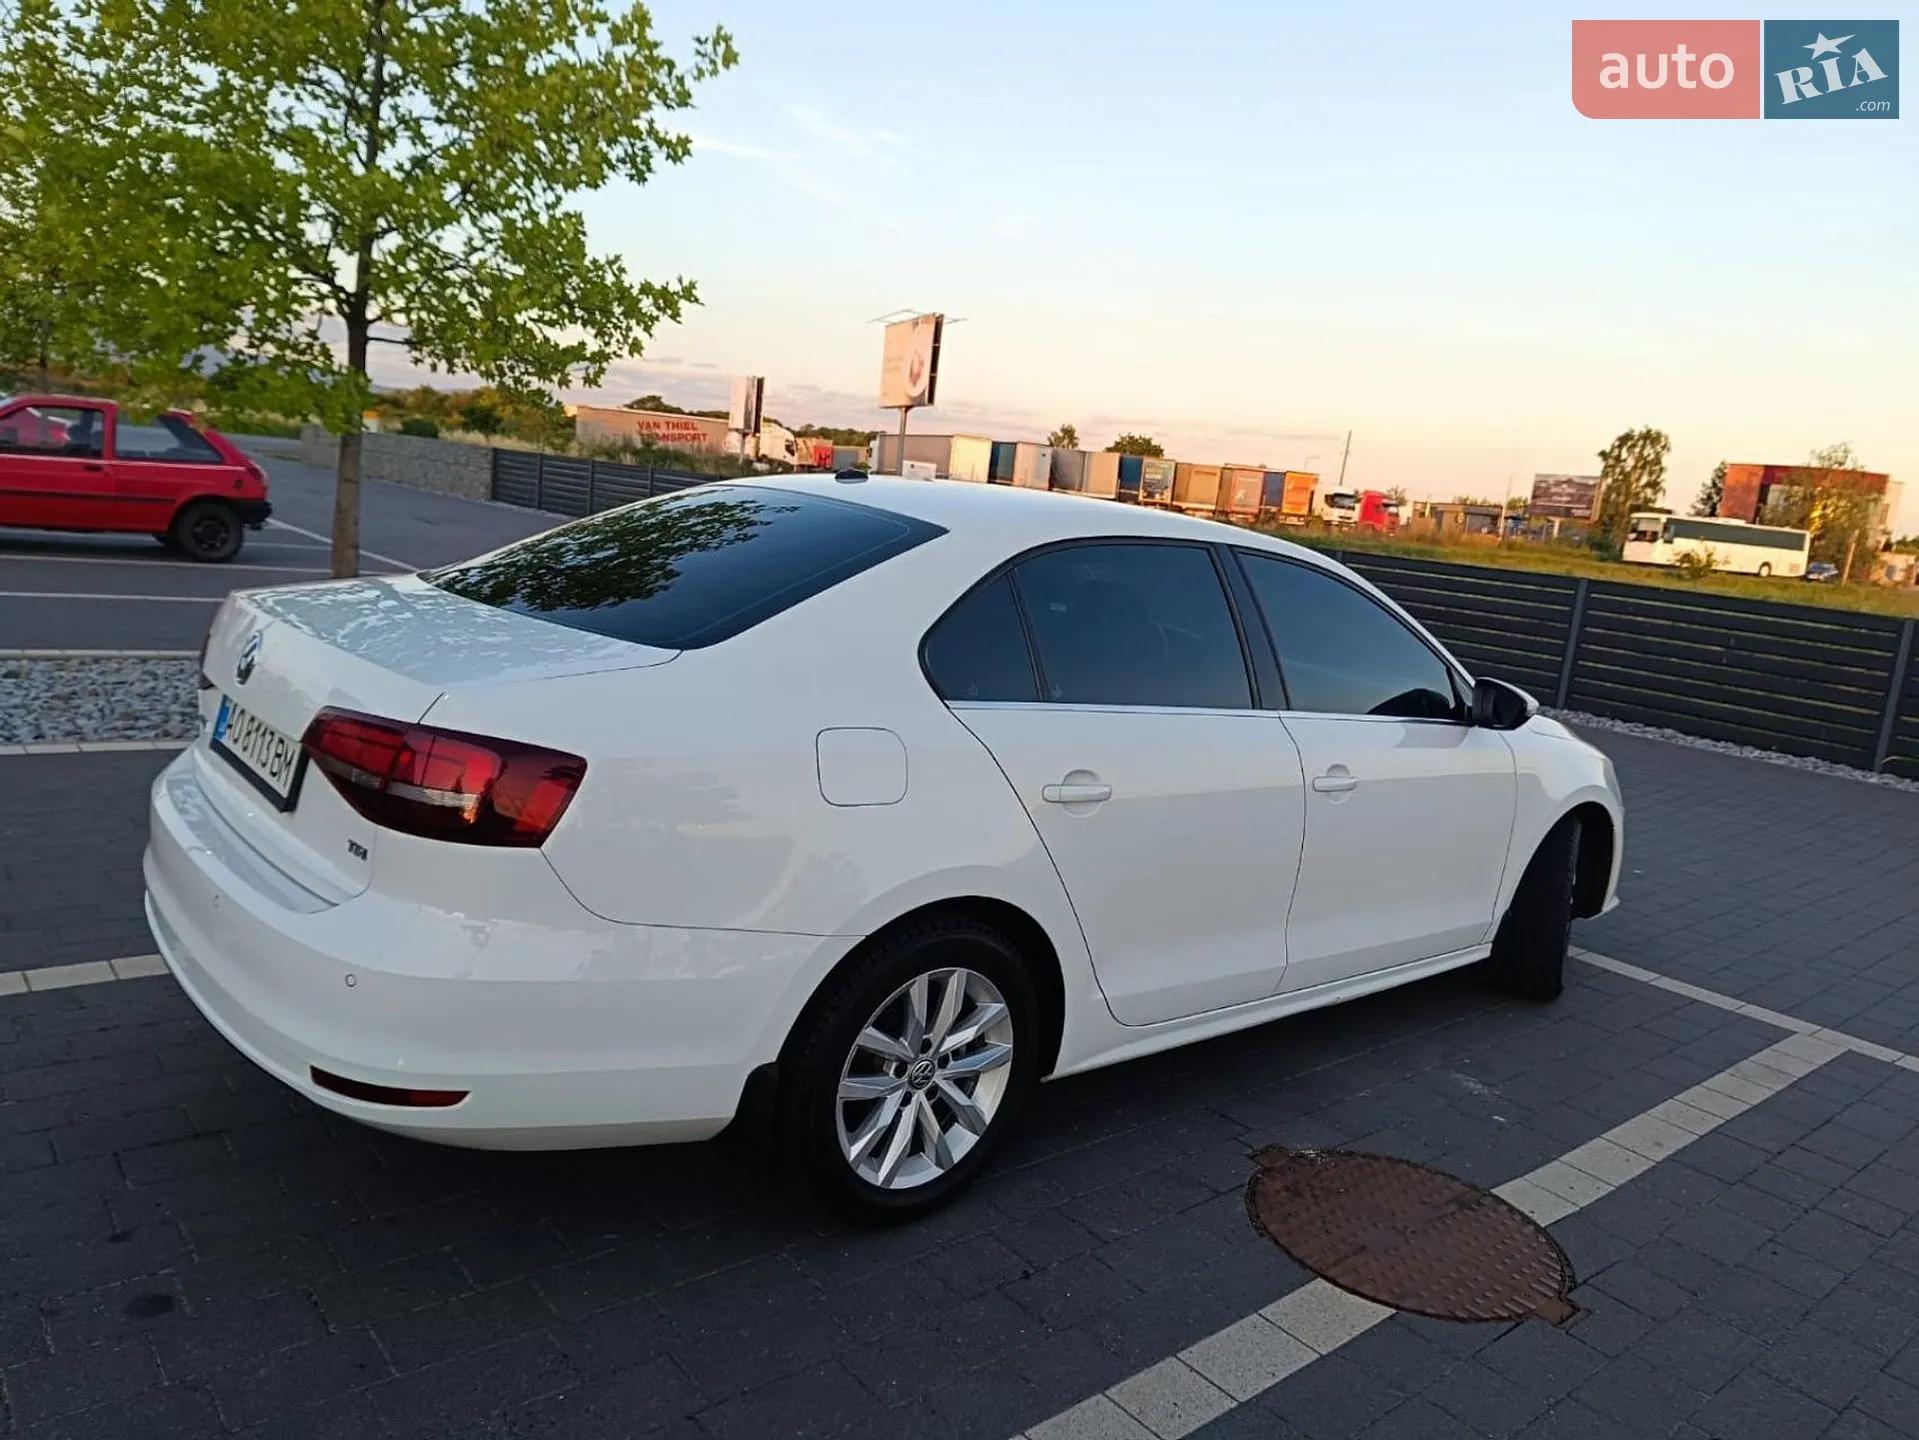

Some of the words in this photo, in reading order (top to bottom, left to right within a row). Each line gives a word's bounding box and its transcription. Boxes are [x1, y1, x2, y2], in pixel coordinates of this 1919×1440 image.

[637, 420, 661, 430] VAN
[665, 420, 698, 431] THIEL
[640, 431, 708, 442] ANSPORT
